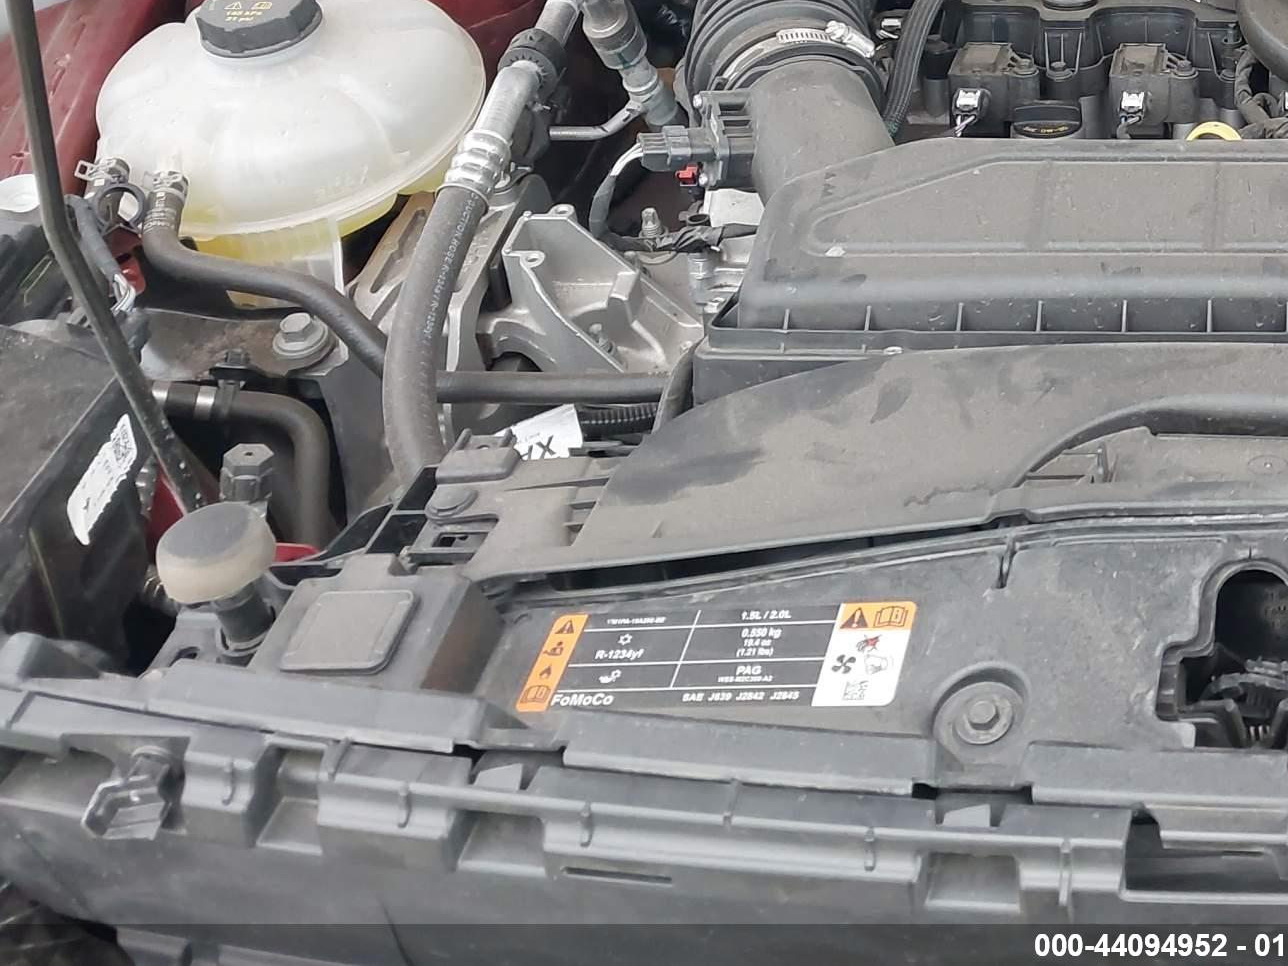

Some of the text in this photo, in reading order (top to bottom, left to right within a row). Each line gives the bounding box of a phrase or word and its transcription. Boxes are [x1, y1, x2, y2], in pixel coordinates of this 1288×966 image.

[768, 627, 782, 639] kg
[595, 649, 644, 661] R-1234yf
[736, 665, 761, 675] PAG
[550, 693, 614, 706] FoMoCo
[682, 692, 704, 701] SAE
